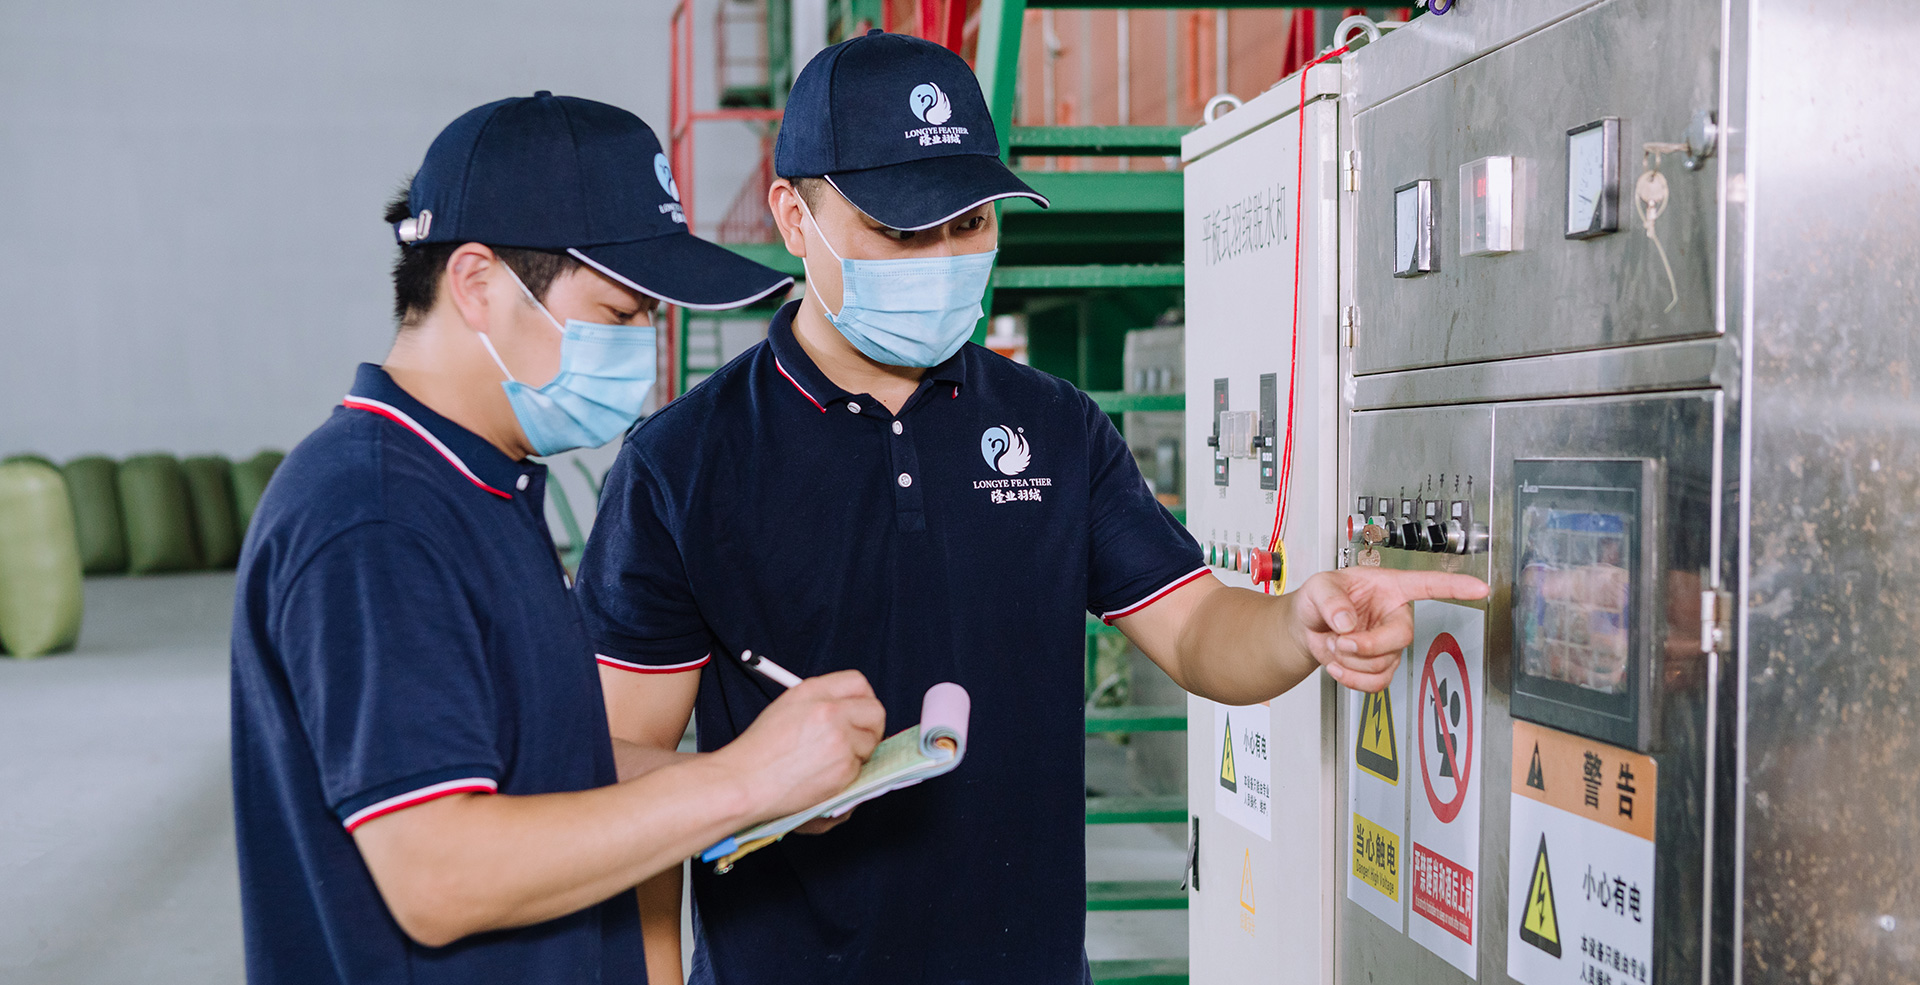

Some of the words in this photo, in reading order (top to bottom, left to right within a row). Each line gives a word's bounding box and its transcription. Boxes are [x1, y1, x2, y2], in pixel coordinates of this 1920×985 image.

[904, 127, 938, 139] LONGYE
[939, 126, 969, 135] FEATHER
[973, 479, 1010, 489] LONGYE
[1242, 727, 1268, 761] 小心有电
[1583, 749, 1637, 822] 警告
[1355, 822, 1396, 876] 当心触电
[1413, 849, 1472, 920] 严禁睡岗和酒后上岗
[1581, 863, 1642, 924] 小心有电
[1580, 934, 1647, 984] 本设备只能由专业
